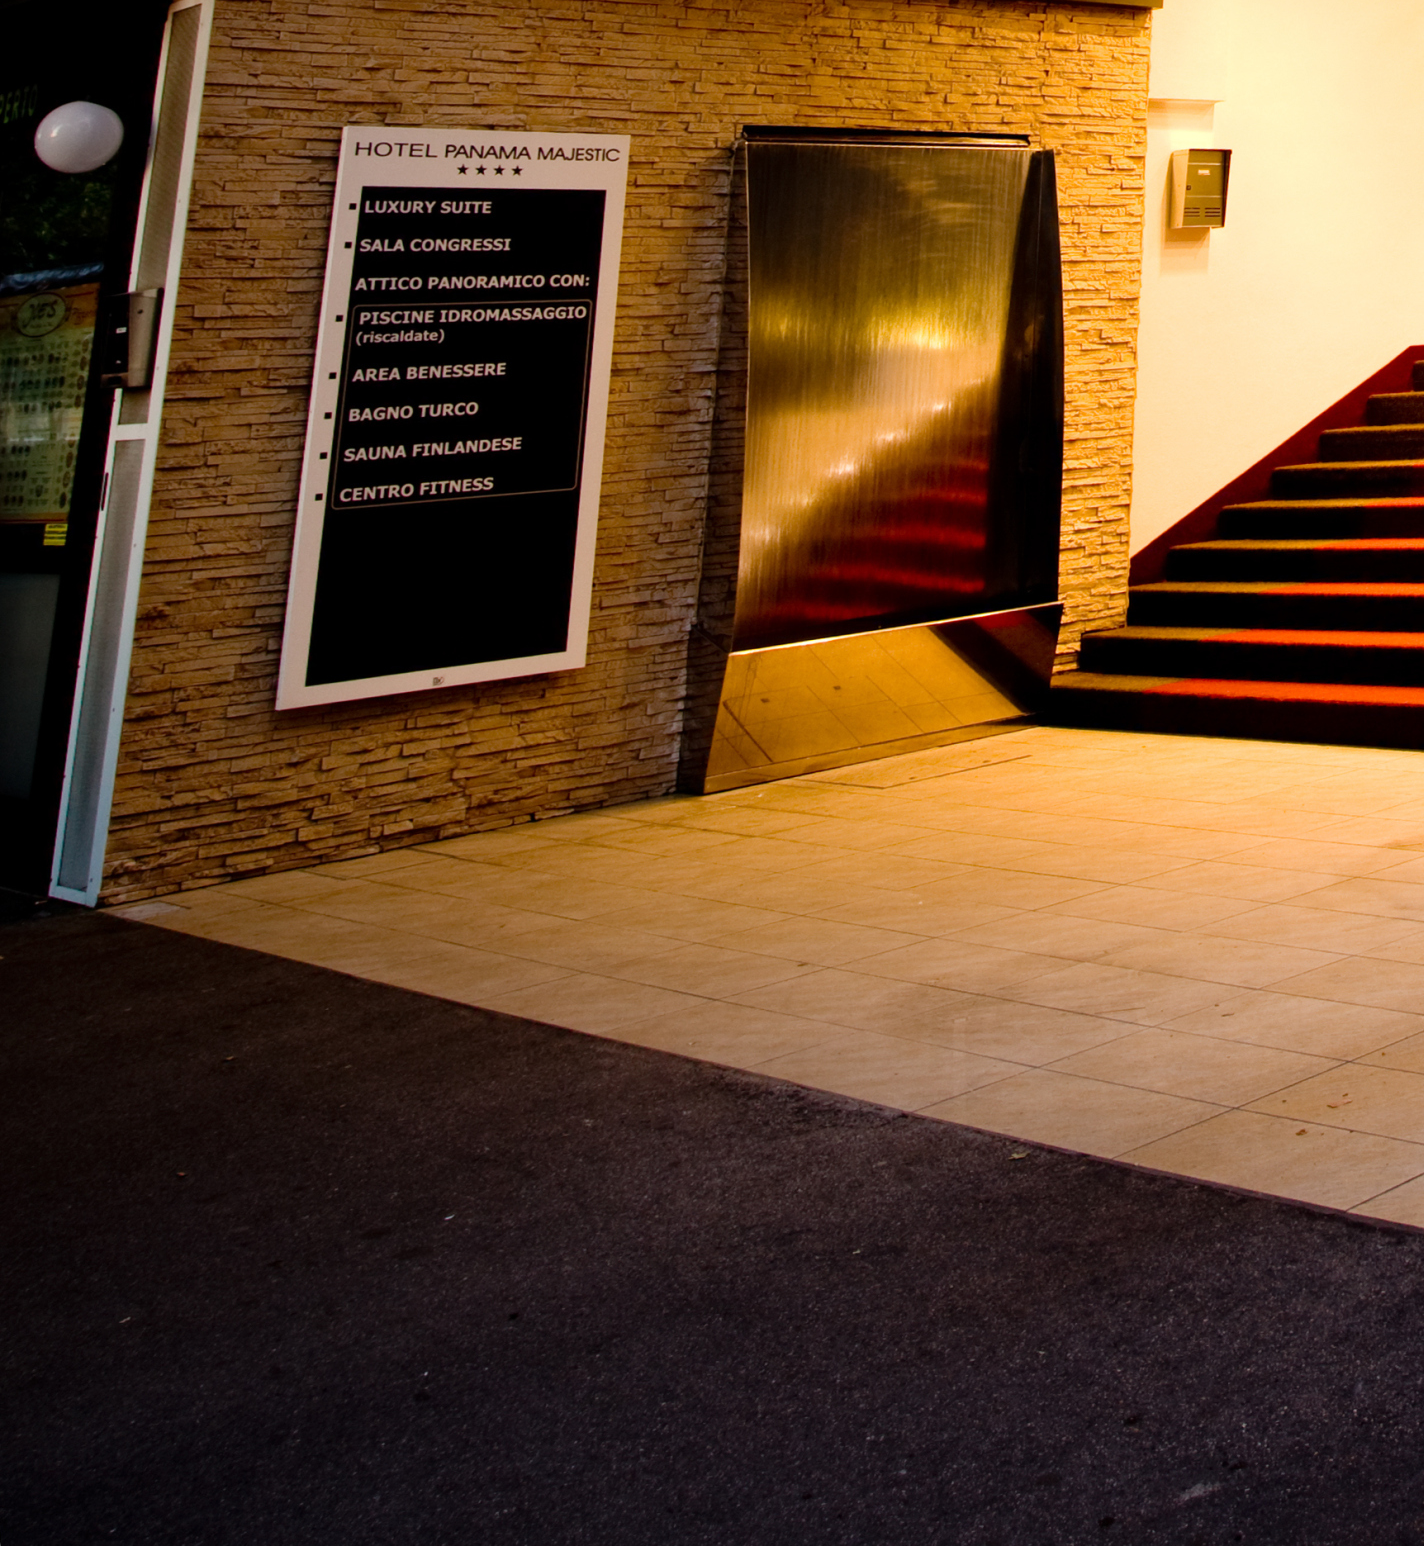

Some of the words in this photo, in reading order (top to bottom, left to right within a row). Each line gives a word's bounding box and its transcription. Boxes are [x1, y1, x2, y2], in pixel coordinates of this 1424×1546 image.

[354, 141, 437, 157] HOTEL
[444, 144, 531, 159] PANAMA
[536, 147, 621, 161] MAJESTIC
[364, 200, 436, 213] LUXURY
[440, 200, 492, 213] SUITE
[359, 238, 404, 251] SALA
[409, 237, 512, 251] CONGRESSI
[354, 276, 422, 290] ATTICO
[427, 274, 545, 288] PANORAMICO
[549, 273, 591, 286] CON:
[358, 310, 434, 324] PISCINE
[439, 305, 587, 322] IDROMASSAGGIO
[355, 328, 445, 345] (riscaldate)
[351, 367, 401, 381] AREA
[405, 361, 507, 379] BENESSERE
[347, 405, 414, 421] BAGNO
[418, 401, 479, 417] TURCO
[343, 445, 407, 461] SAUNA
[411, 436, 523, 457] FINLANDESE
[338, 483, 414, 501] CENTRO
[418, 476, 494, 494] FITNESS
